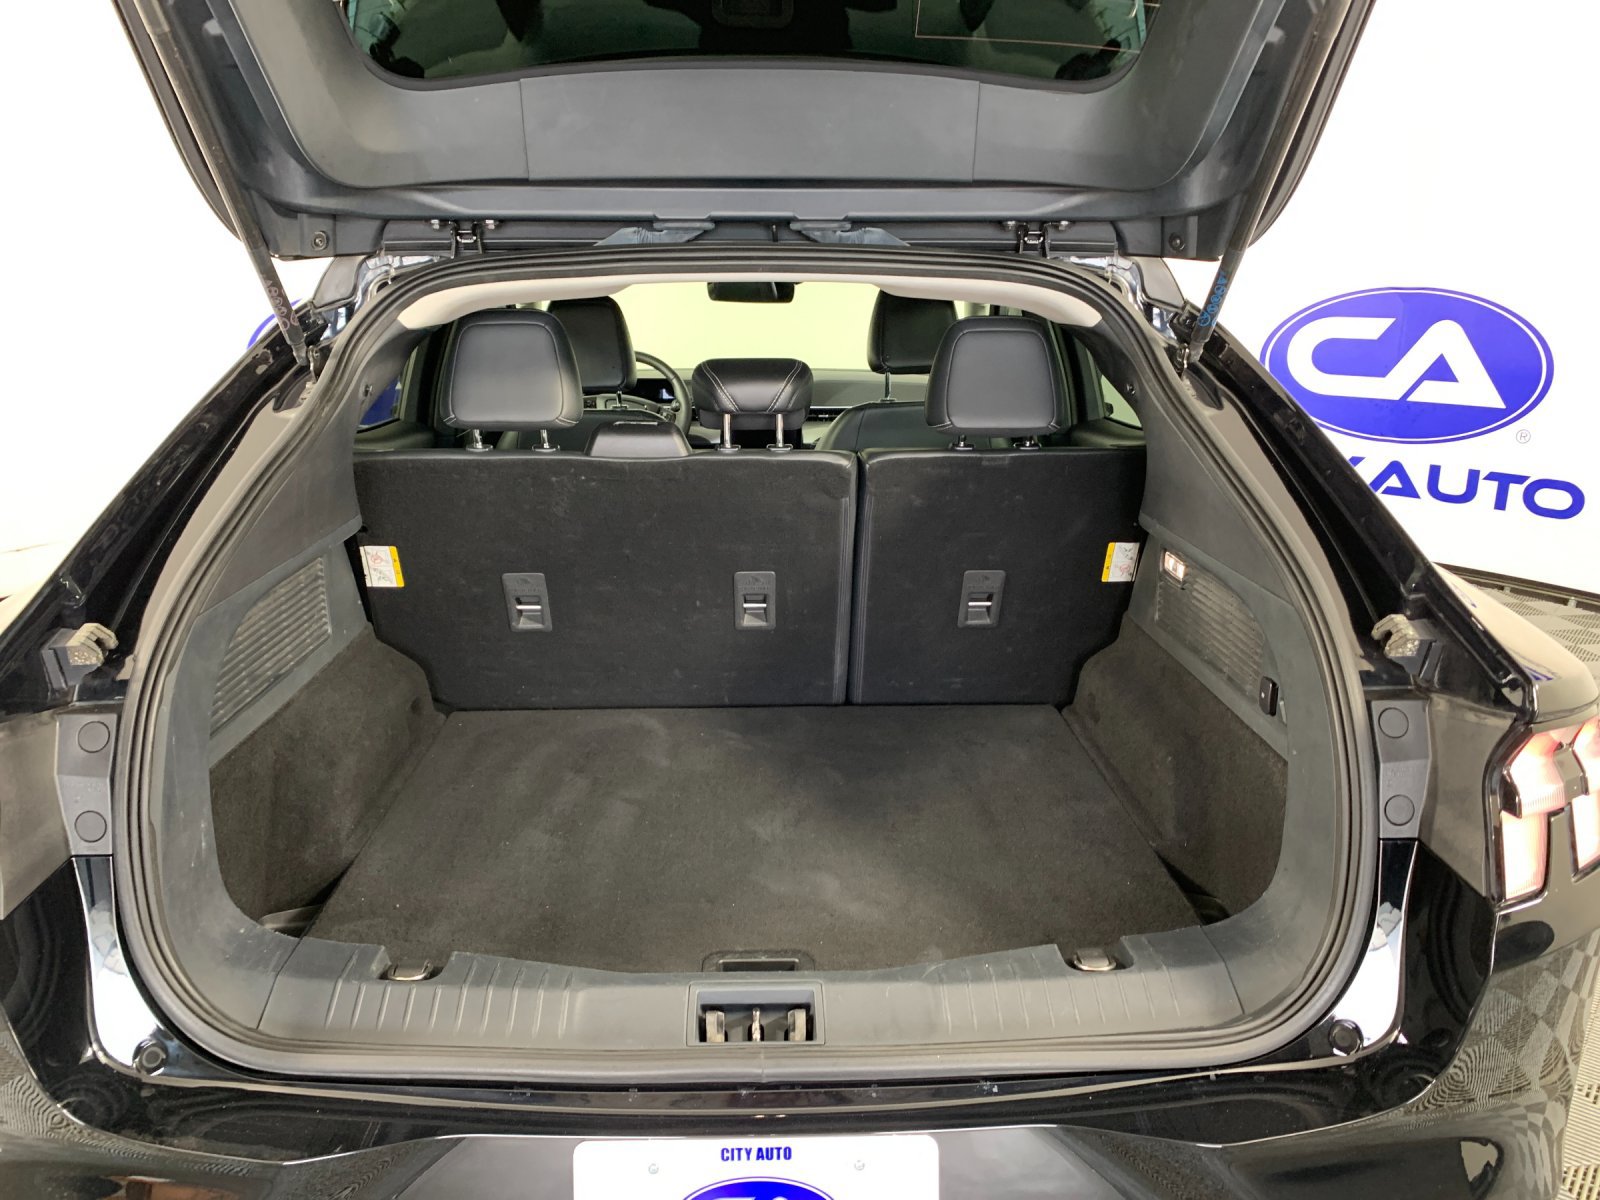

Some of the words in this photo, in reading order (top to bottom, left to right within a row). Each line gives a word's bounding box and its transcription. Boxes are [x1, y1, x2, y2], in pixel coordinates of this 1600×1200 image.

[1286, 316, 1507, 409] CA
[1348, 455, 1586, 520] AUTO
[720, 1147, 753, 1162] CITY
[755, 1146, 793, 1161] AUTO
